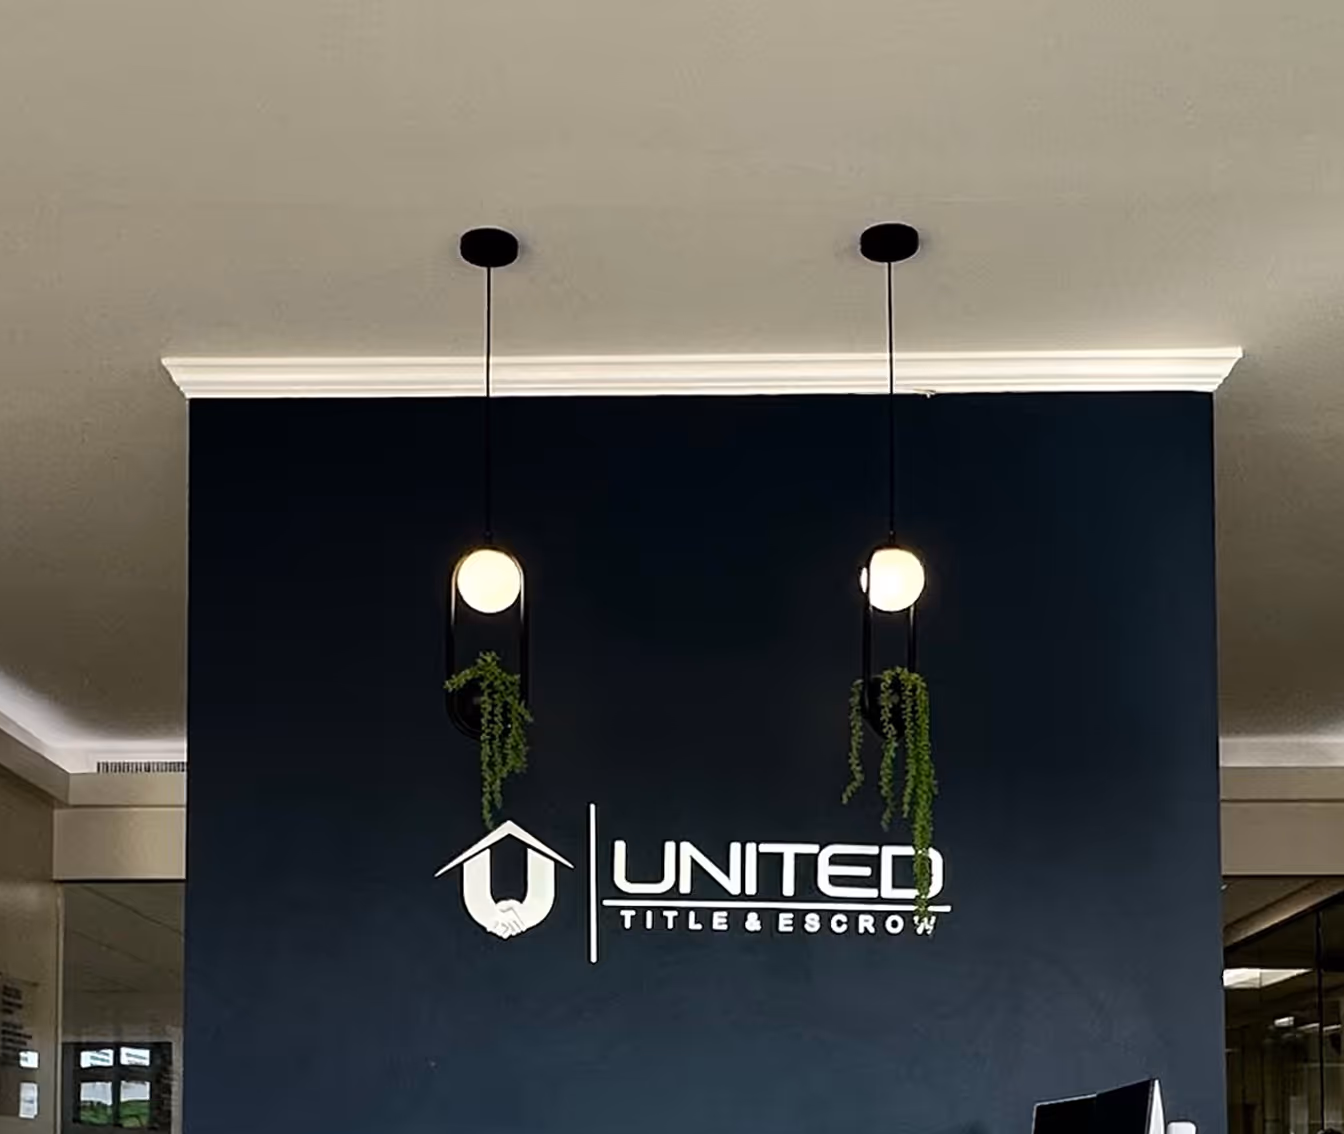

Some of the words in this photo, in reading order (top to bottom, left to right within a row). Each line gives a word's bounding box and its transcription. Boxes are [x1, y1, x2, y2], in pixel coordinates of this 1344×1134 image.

[613, 840, 944, 899] UNITED
[620, 909, 730, 931] TITLE
[744, 912, 762, 932] &
[777, 912, 937, 936] ESCROW
